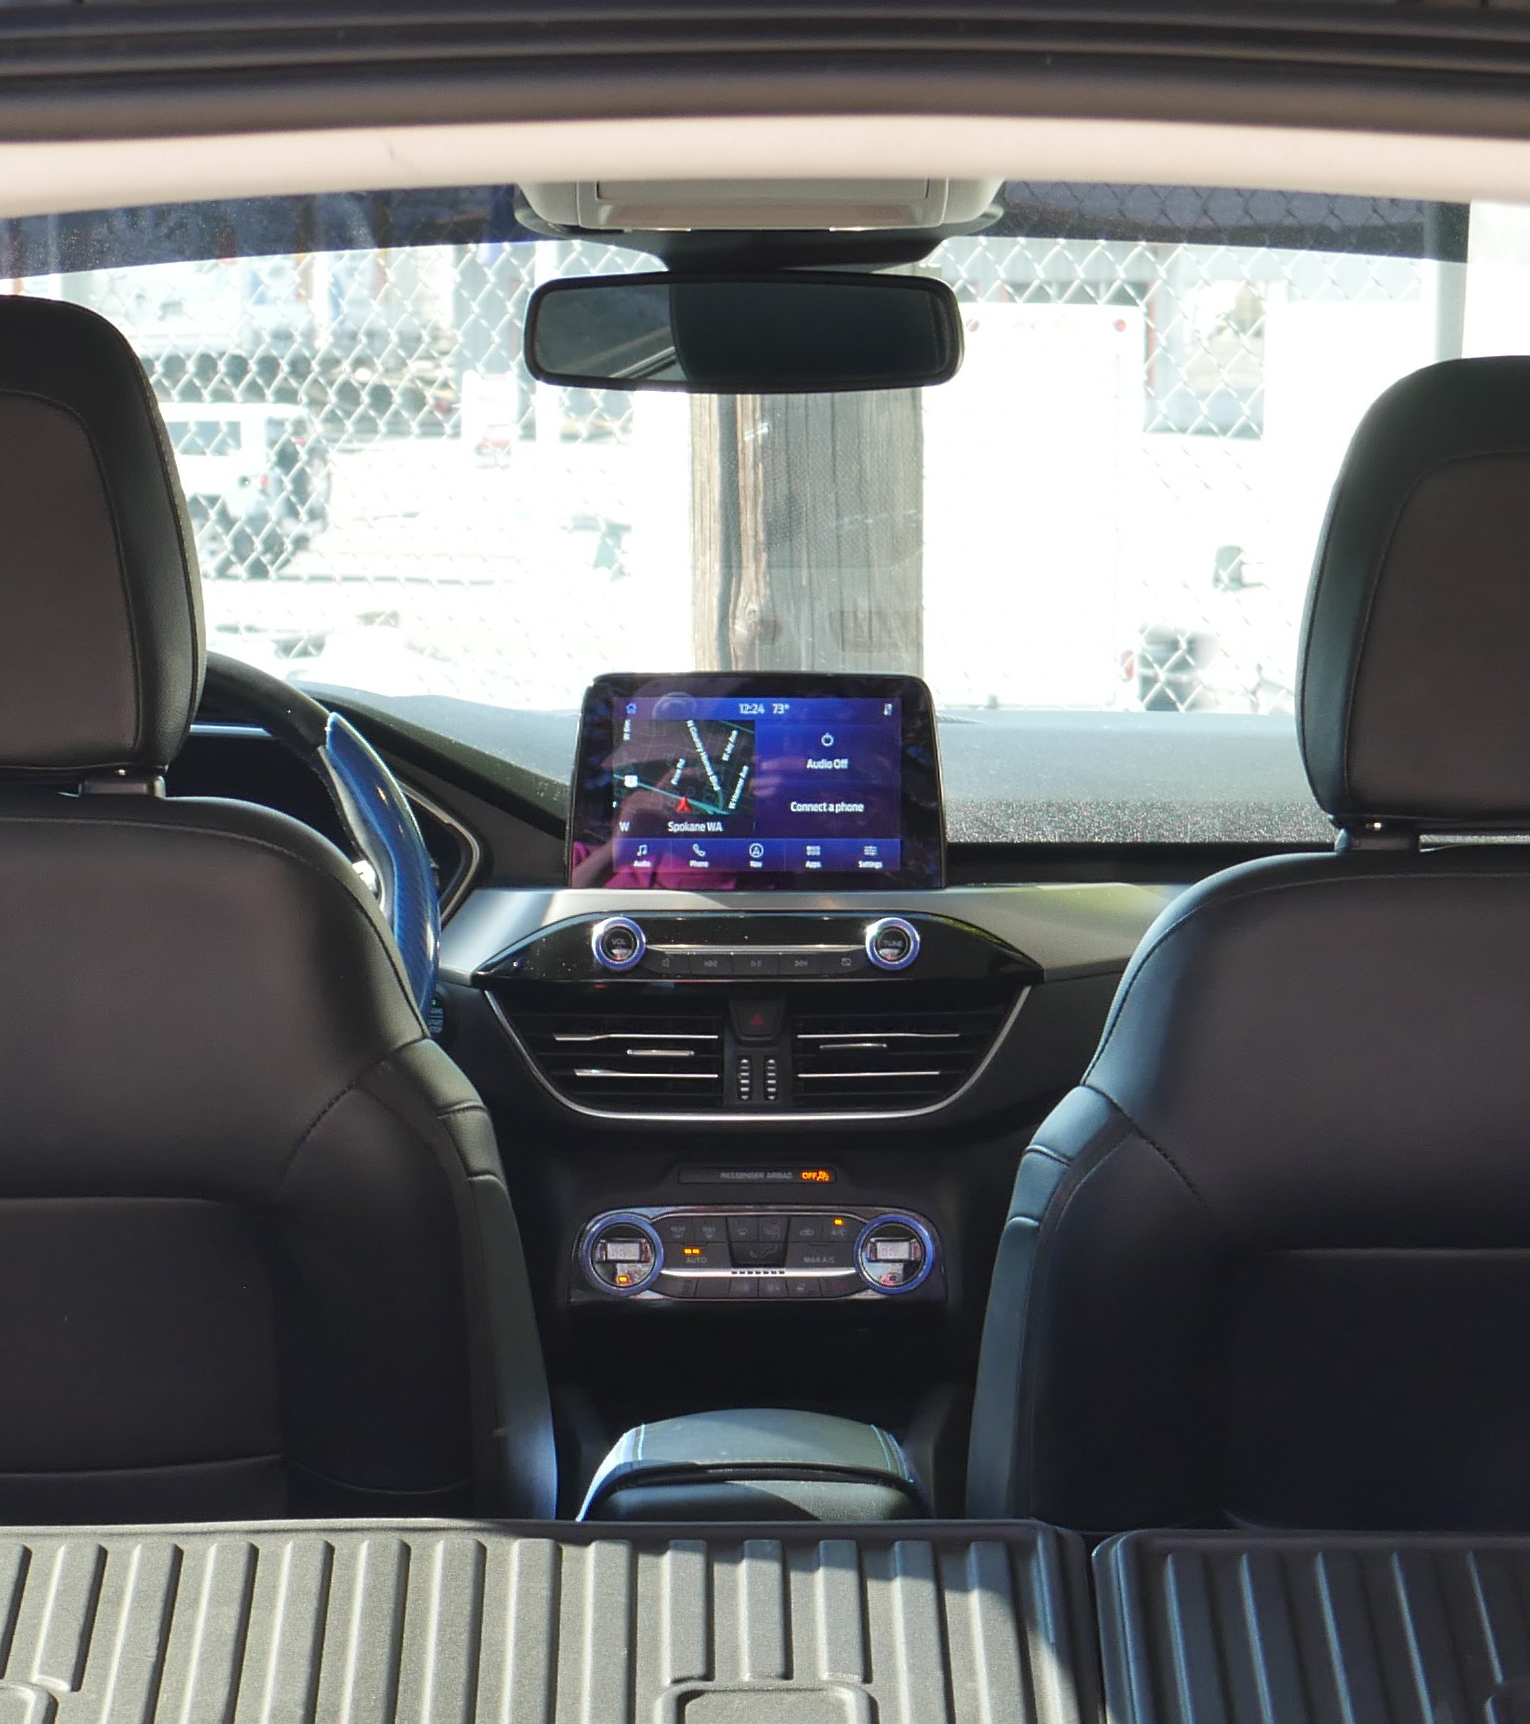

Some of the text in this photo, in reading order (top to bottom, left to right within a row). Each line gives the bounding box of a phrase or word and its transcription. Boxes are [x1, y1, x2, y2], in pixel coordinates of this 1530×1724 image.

[739, 703, 765, 714] 12:24
[807, 758, 849, 769] Audio Off
[791, 802, 865, 813] Connect a phone
[619, 821, 630, 832] W
[668, 821, 723, 832] Spokane WA
[805, 861, 822, 869] Apps
[858, 861, 883, 869] Settings
[685, 1256, 707, 1264] AUTO
